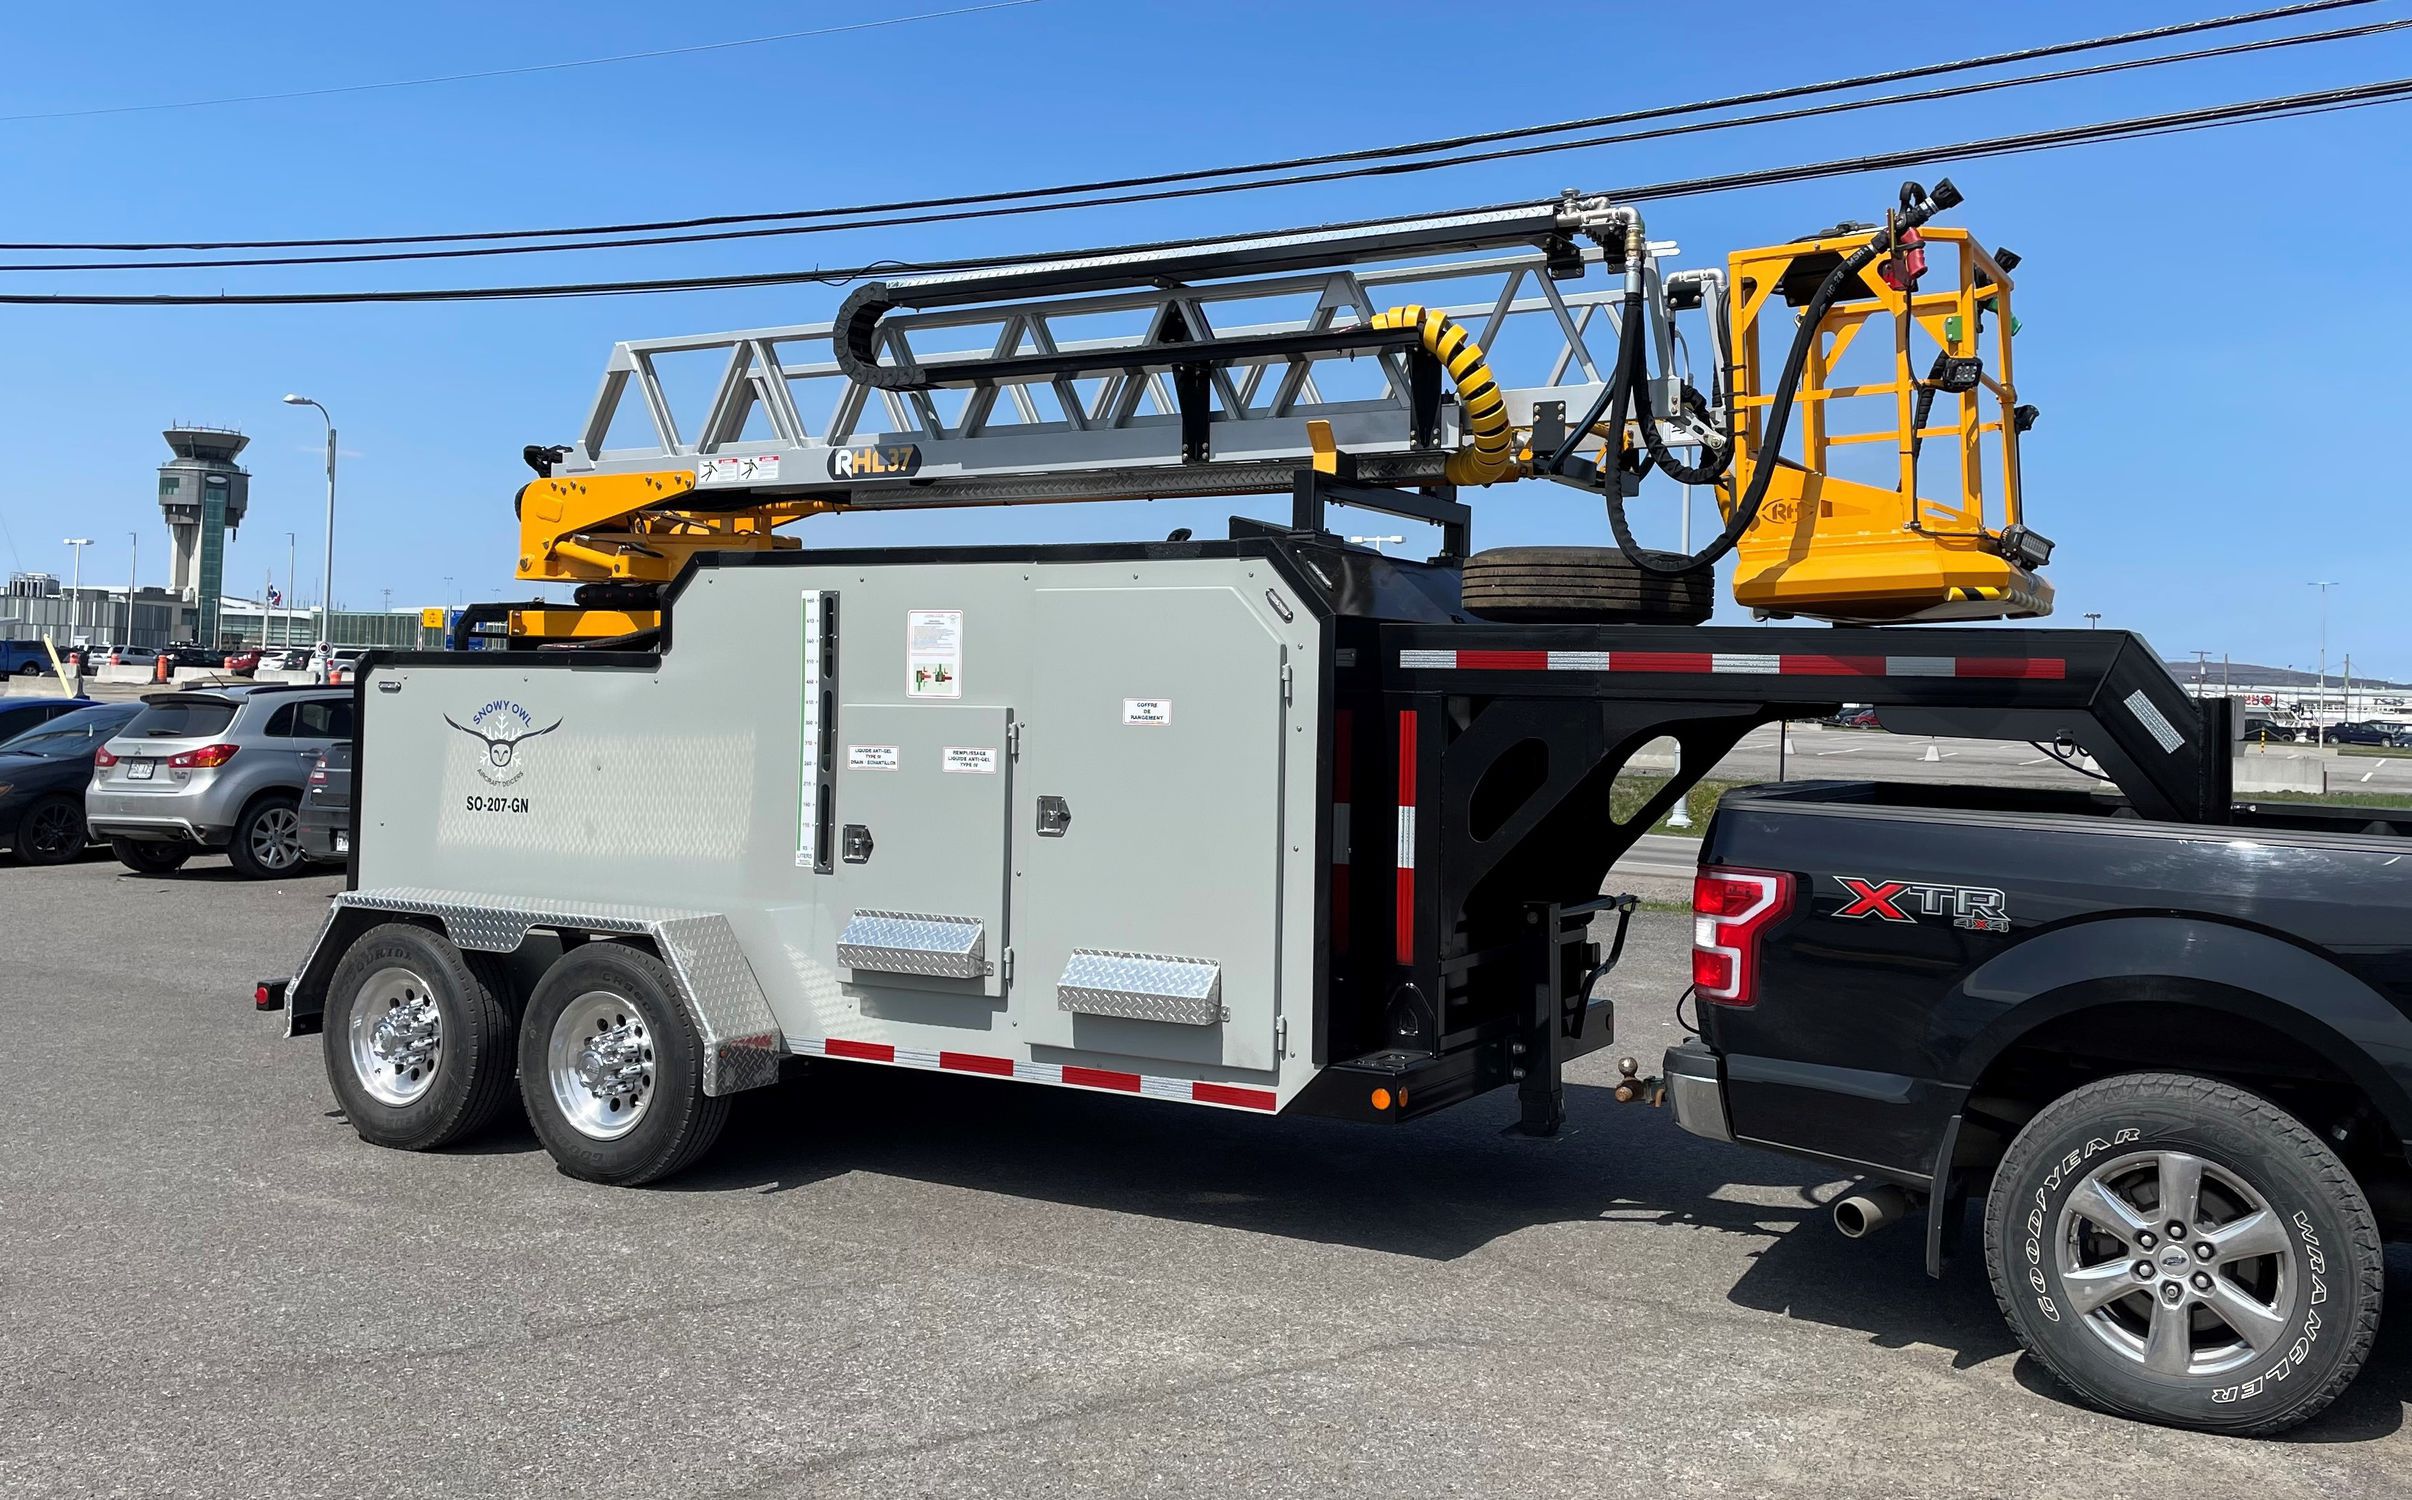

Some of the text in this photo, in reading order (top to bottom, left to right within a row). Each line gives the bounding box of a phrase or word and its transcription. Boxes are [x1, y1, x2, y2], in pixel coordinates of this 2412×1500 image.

[472, 700, 532, 728] SNOWY OWL
[476, 768, 524, 788] AIRCRAFT DEICERS
[466, 796, 529, 813] SO-207-GN
[1831, 875, 2012, 924] XTR
[2025, 1128, 2141, 1323] GOODYEAR
[2211, 1210, 2327, 1404] WRANGLER
